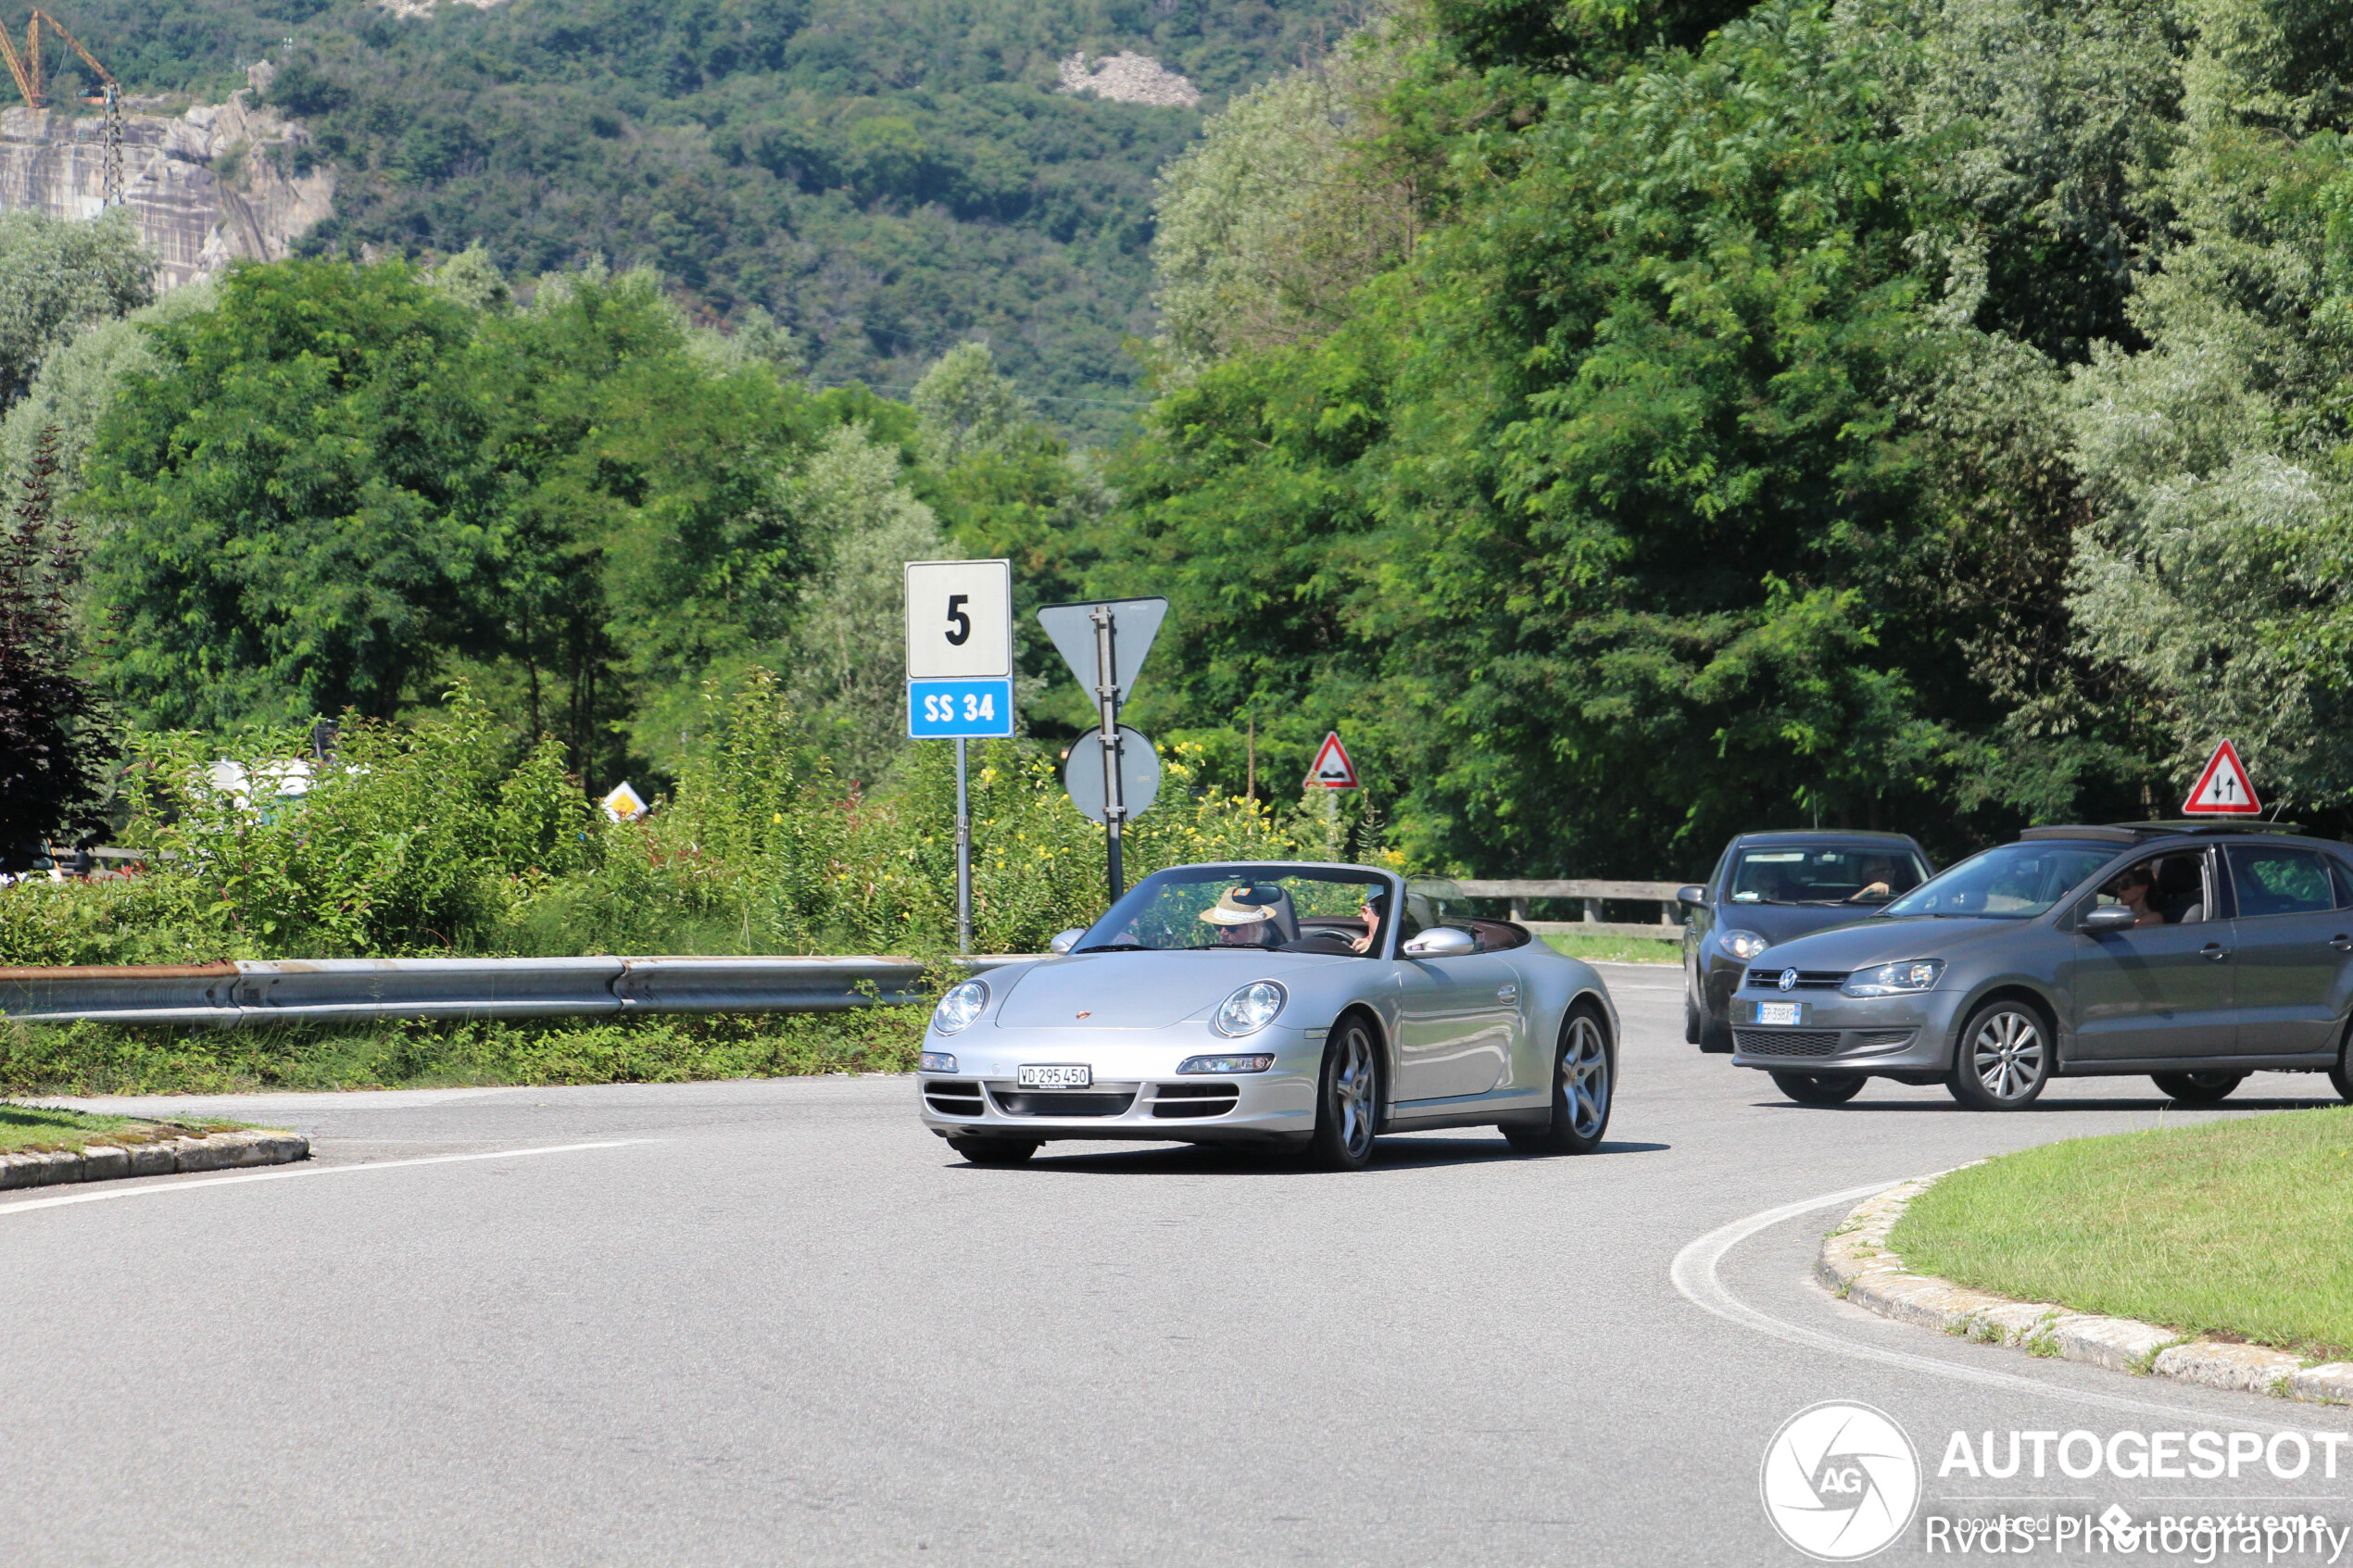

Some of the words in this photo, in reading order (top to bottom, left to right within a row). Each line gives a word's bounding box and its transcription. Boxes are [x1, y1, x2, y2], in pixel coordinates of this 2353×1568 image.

[945, 594, 970, 646] 5
[924, 694, 954, 721] SS
[963, 693, 995, 721] 34
